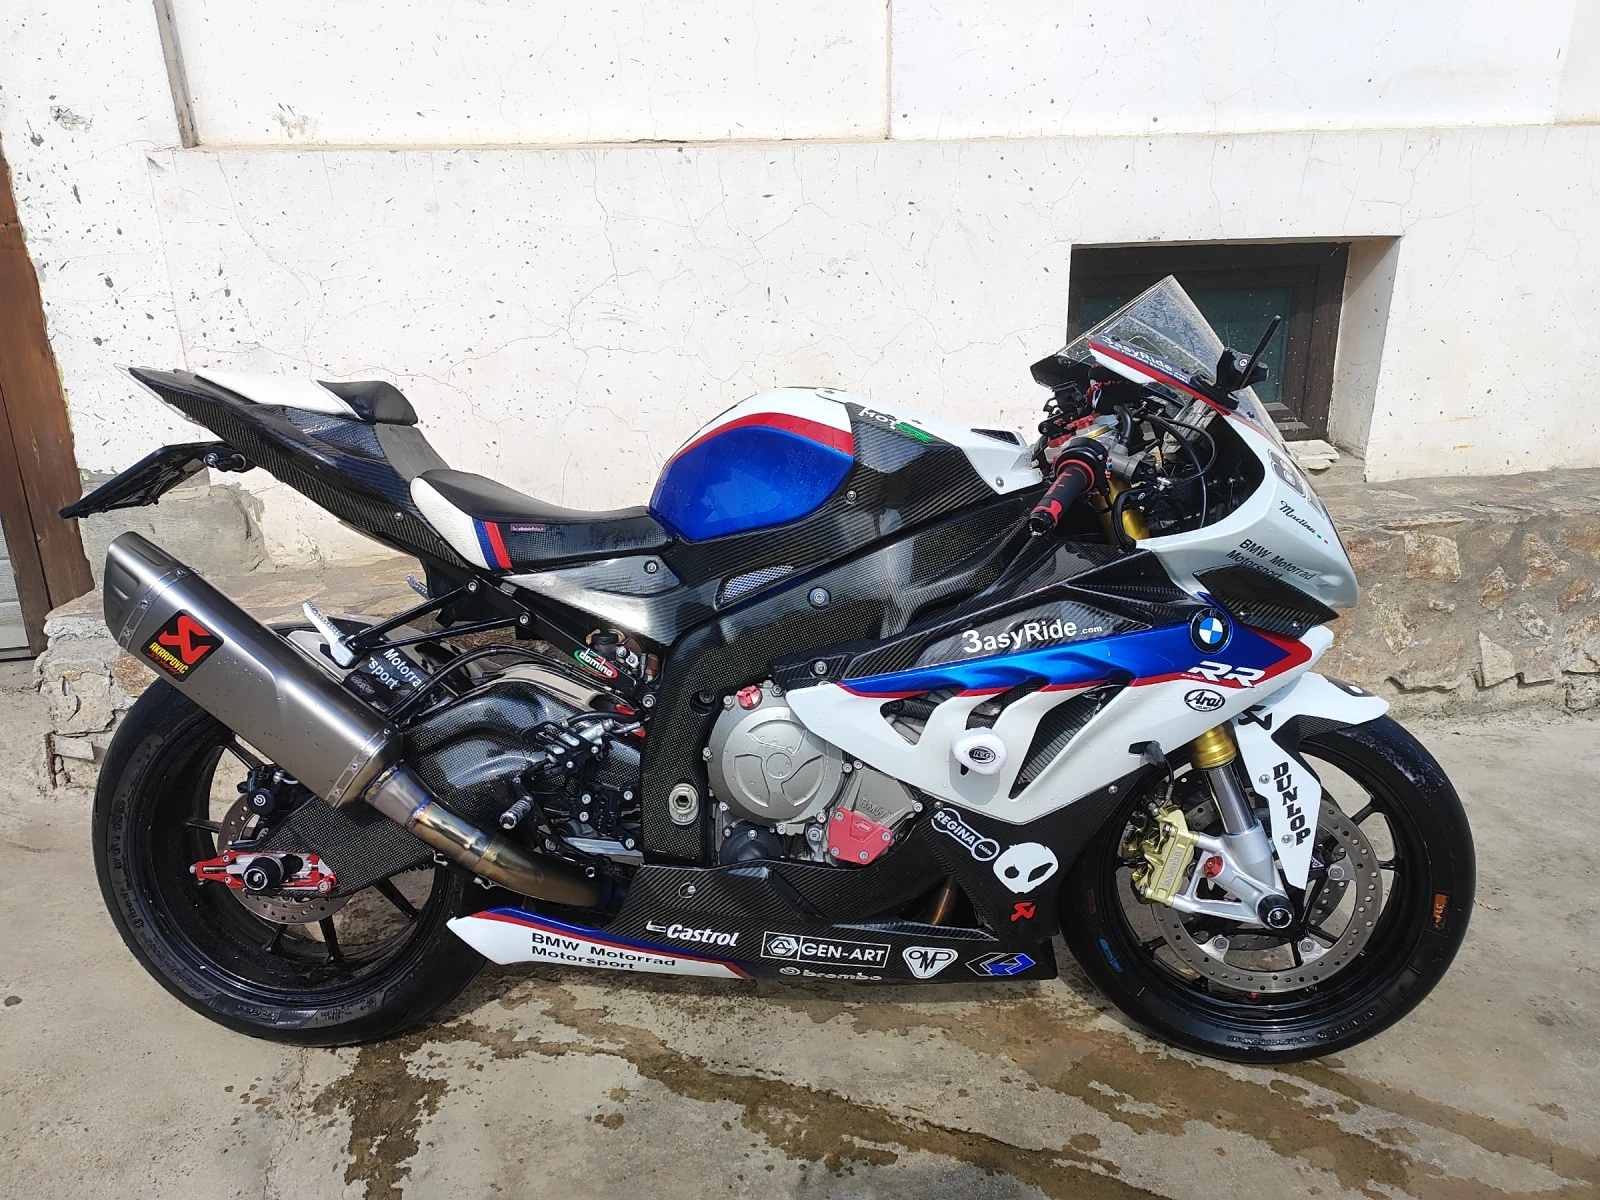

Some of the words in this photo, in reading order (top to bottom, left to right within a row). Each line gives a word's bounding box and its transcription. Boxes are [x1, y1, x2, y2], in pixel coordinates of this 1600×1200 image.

[1239, 538, 1272, 558] BMW
[1269, 555, 1317, 580] Motorrad
[961, 617, 1078, 654] 3asyRide
[1080, 625, 1103, 635] .com
[383, 648, 422, 688] Motorra
[578, 648, 614, 677] domino
[1187, 660, 1266, 688] RR
[1185, 691, 1222, 708] Arai
[1272, 761, 1311, 846] DUNLOP
[933, 810, 976, 845] REGINA
[531, 932, 580, 951] BMW
[590, 946, 676, 966] Motorrad
[667, 924, 740, 947] Castrol
[531, 945, 635, 969] Motorsport
[801, 943, 885, 962] GEN-ART
[802, 969, 882, 981] brembo
